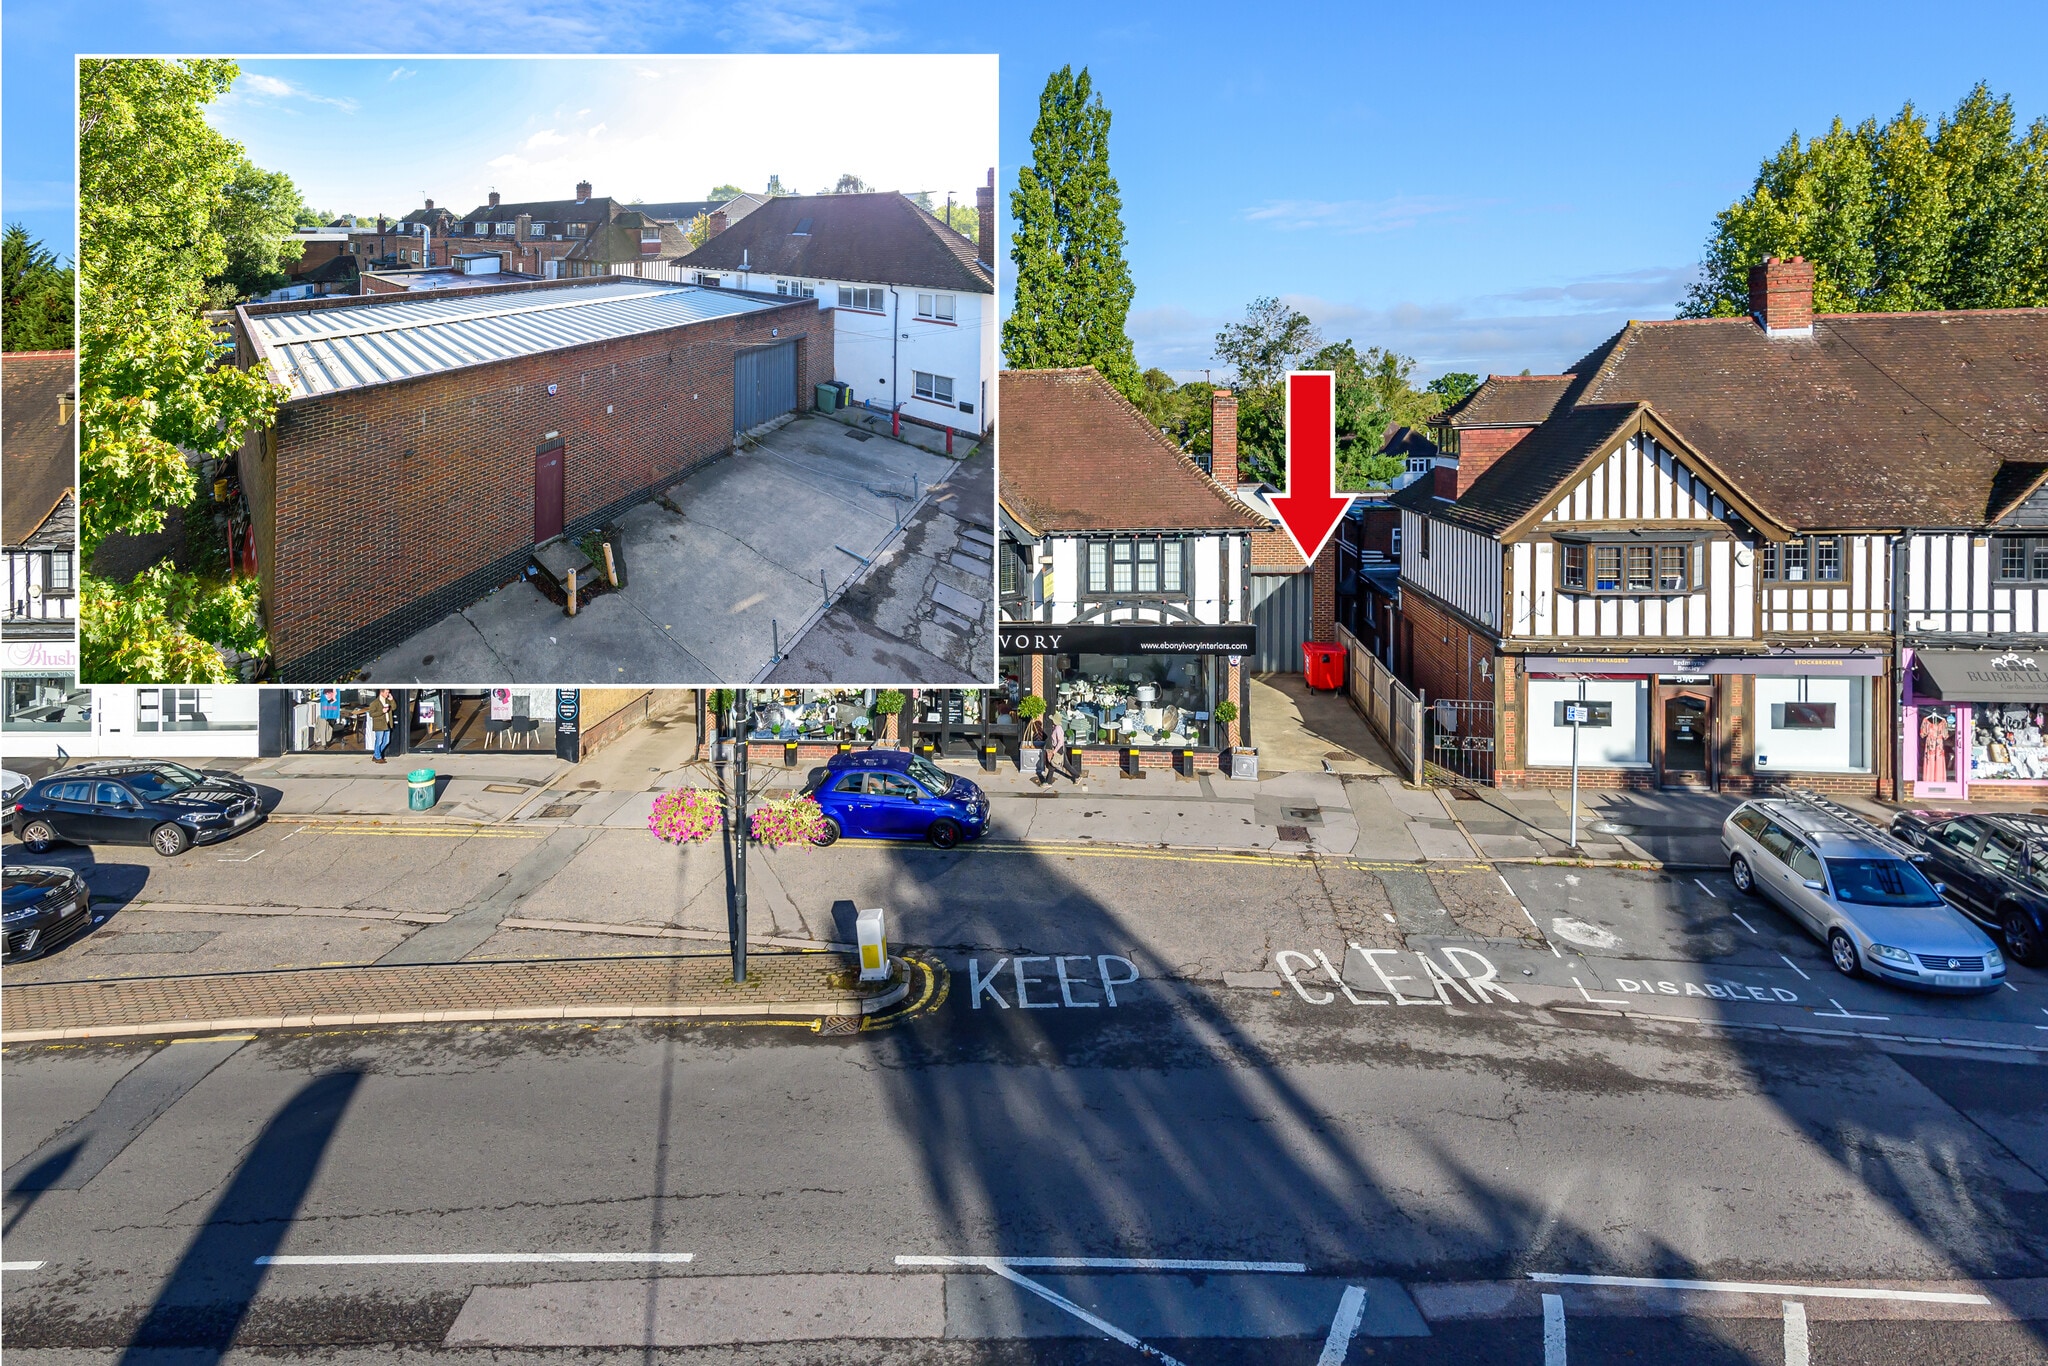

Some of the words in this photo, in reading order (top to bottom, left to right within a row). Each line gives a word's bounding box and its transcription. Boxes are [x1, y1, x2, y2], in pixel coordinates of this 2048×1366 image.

[999, 634, 1062, 649] VORY
[1140, 641, 1248, 651] www.ebonyivoryinteriors.com
[8, 643, 75, 666] Blush
[1967, 672, 2024, 682] BUBBA
[969, 955, 1140, 1009] KEEP
[1275, 943, 1520, 1006] CLEAR
[1615, 978, 1799, 1003] DISABLED
